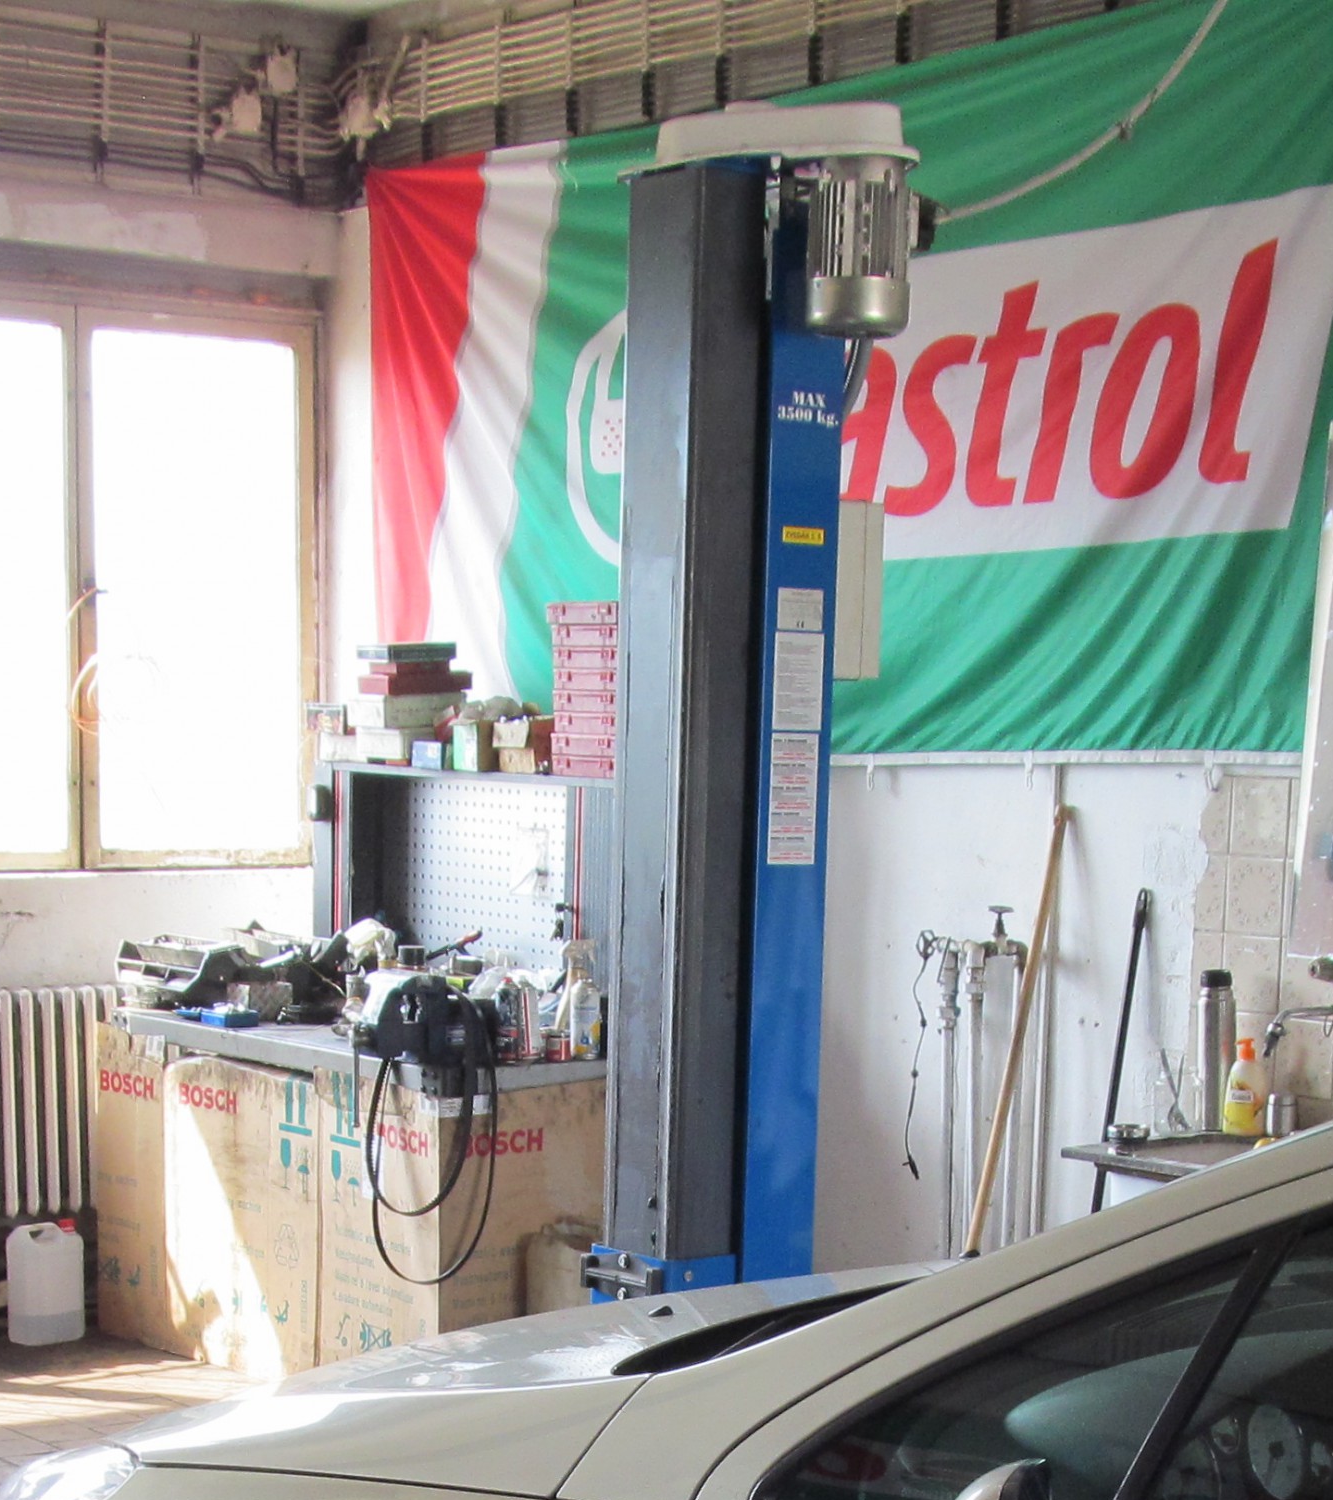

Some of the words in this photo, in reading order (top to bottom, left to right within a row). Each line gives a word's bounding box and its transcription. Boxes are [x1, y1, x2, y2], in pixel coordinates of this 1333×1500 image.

[839, 238, 1279, 517] astrol
[792, 391, 826, 408] MAX
[777, 405, 813, 423] 3500
[816, 408, 839, 428] kg.
[99, 1068, 155, 1100] BOSCH
[178, 1082, 238, 1115] BOSCH
